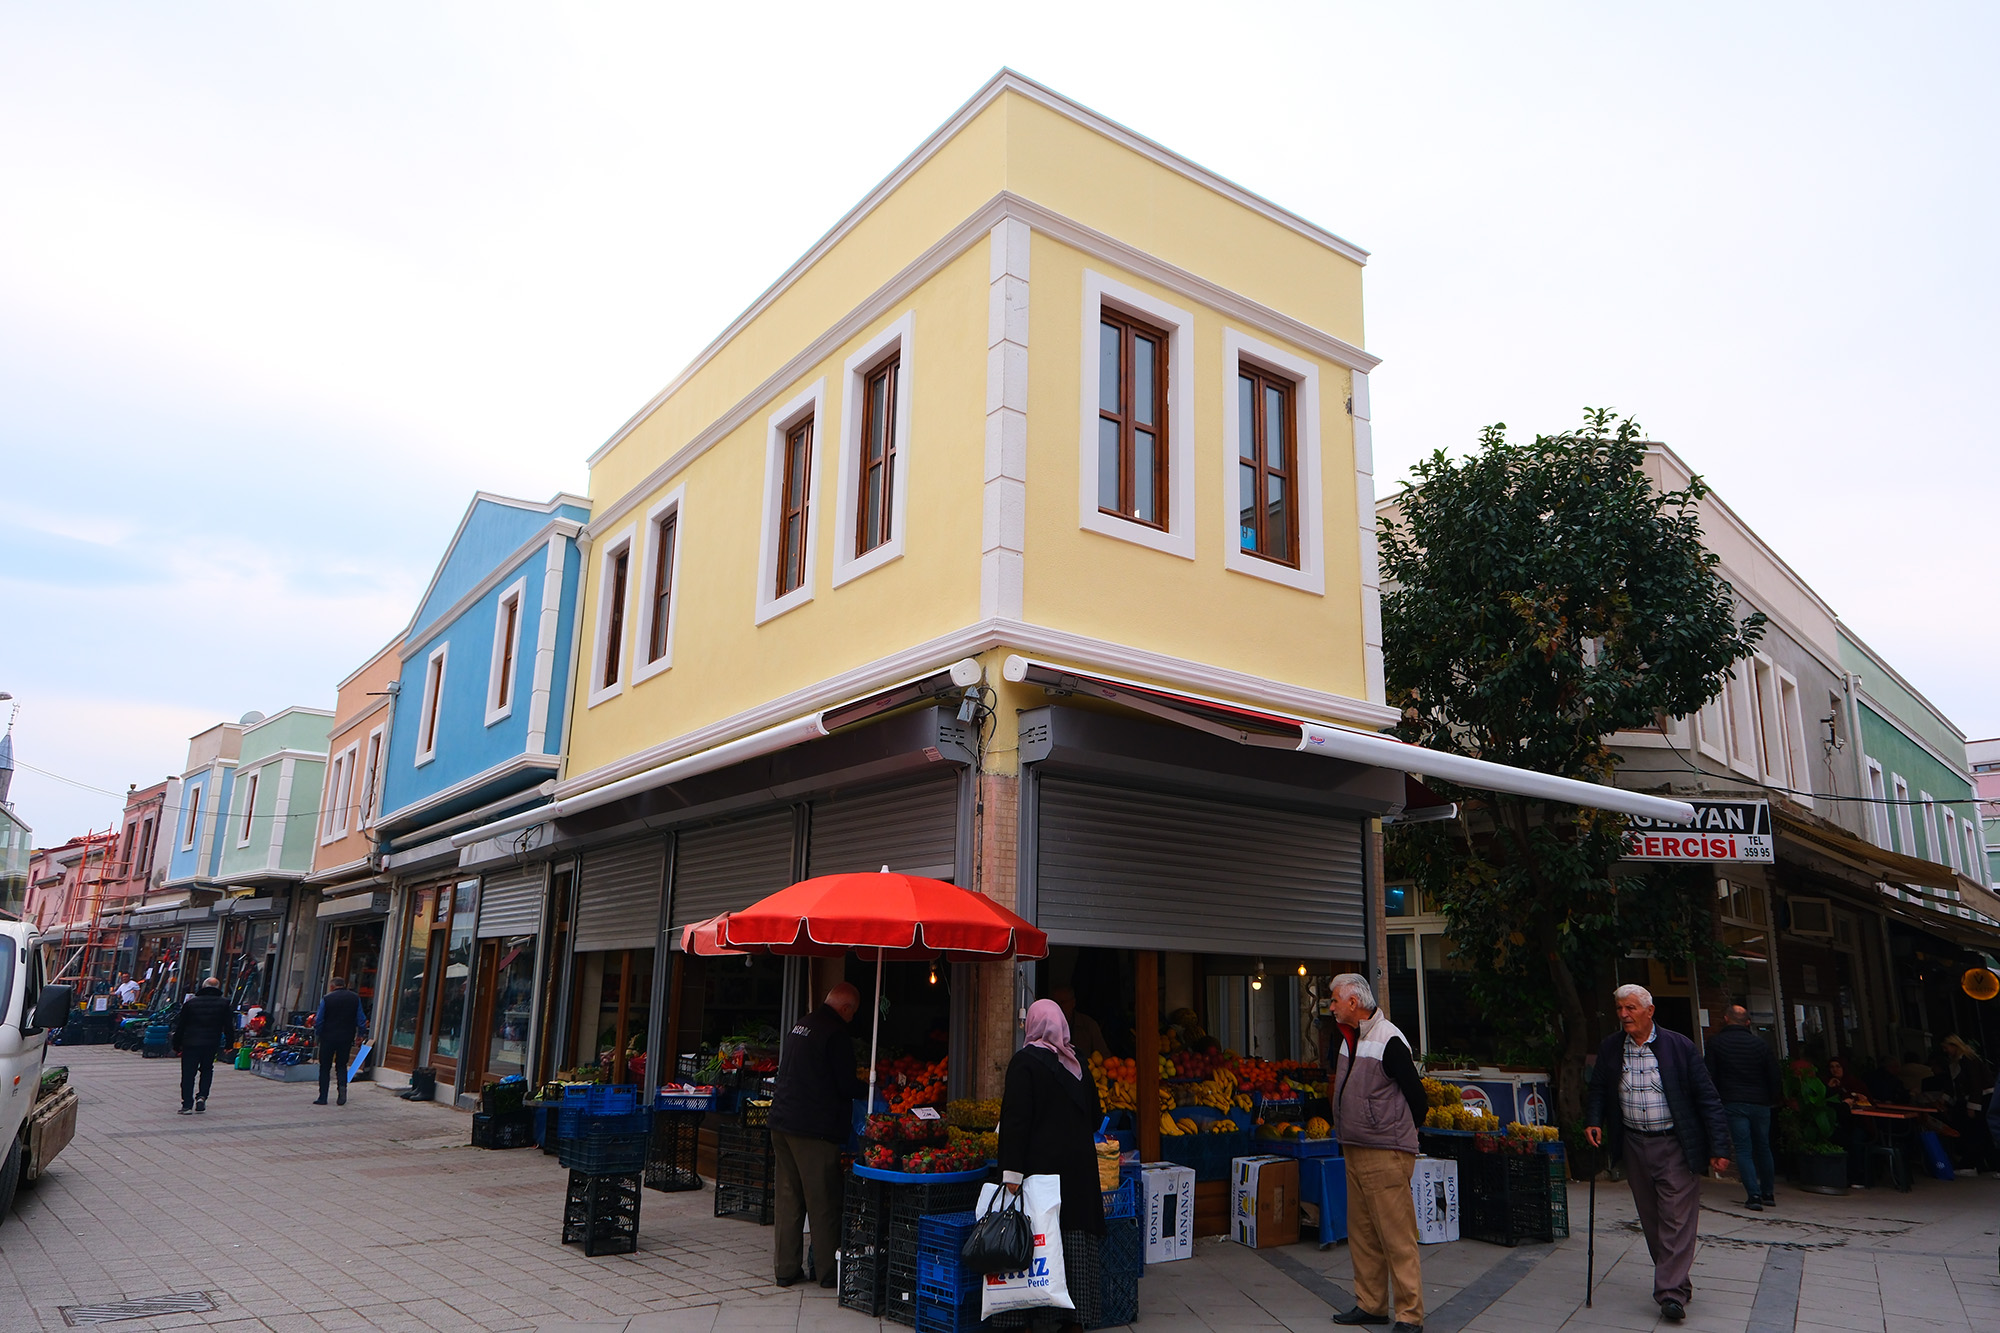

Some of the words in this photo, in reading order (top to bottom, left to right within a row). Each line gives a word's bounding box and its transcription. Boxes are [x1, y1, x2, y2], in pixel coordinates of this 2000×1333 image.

[1744, 847, 1759, 857] 359
[1760, 848, 1770, 858] 95
[1748, 836, 1764, 846] TEL
[1150, 1193, 1160, 1246] BONITA
[1180, 1181, 1190, 1247] BANANAS
[1424, 1172, 1434, 1232] BANANAS
[1447, 1176, 1457, 1222] BONITA
[1027, 1277, 1050, 1288] Perde
